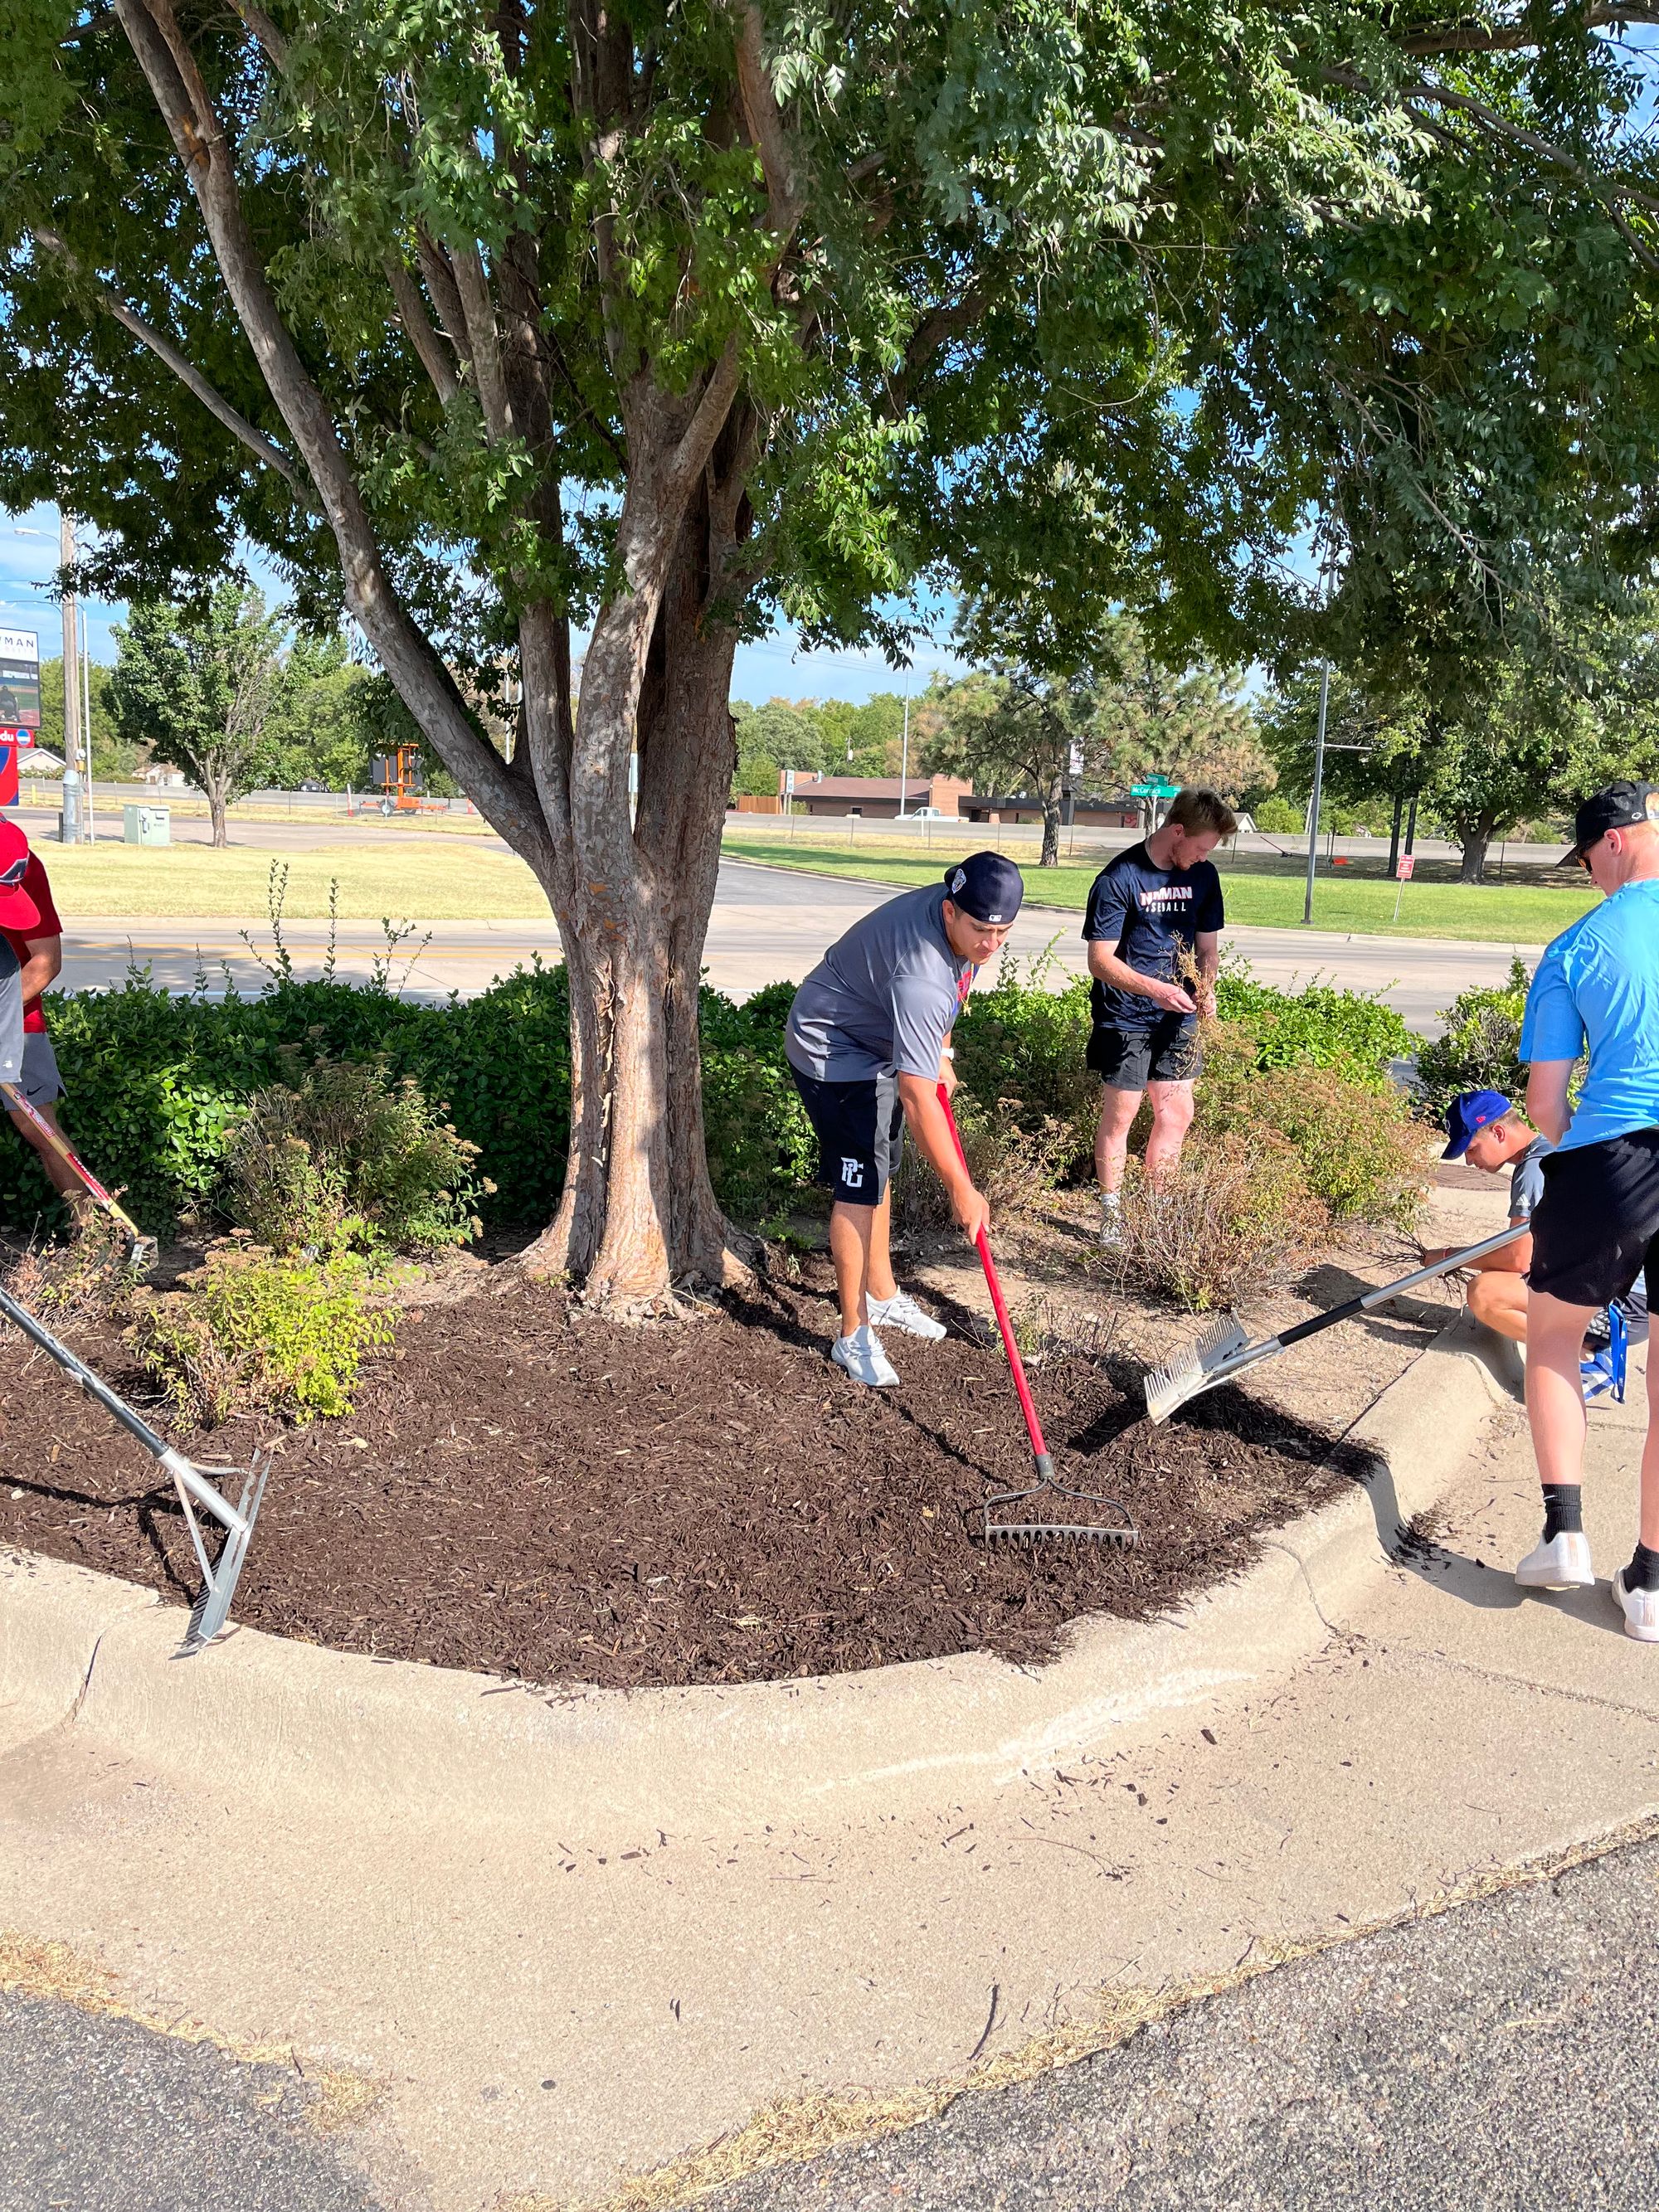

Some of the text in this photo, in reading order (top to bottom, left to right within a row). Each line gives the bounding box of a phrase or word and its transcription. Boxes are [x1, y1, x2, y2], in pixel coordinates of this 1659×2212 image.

[0, 636, 34, 648] MAN
[0, 731, 14, 741] du
[1140, 887, 1192, 906] NMAN
[1146, 902, 1186, 912] SEBALL
